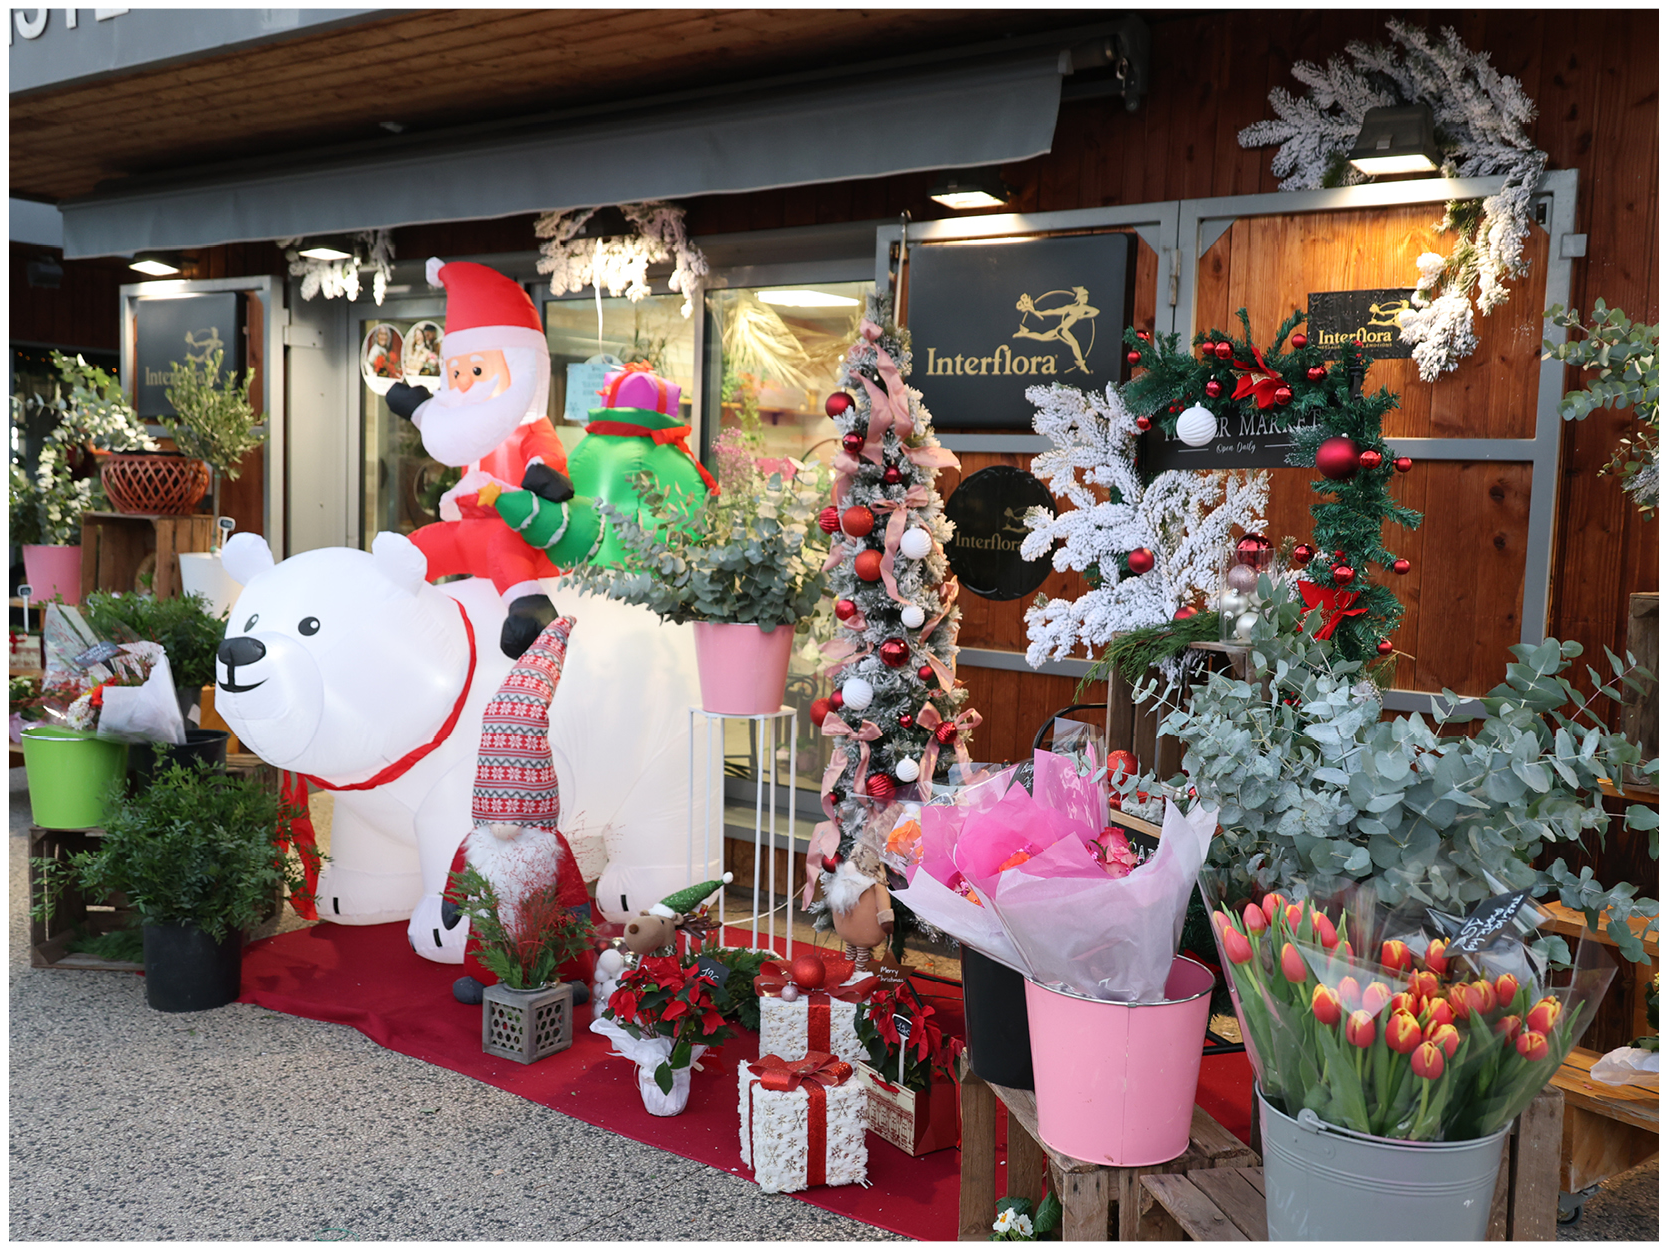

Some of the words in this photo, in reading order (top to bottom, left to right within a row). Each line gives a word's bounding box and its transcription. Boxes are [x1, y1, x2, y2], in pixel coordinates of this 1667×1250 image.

[1318, 326, 1393, 345] Interflora
[926, 344, 1058, 375] Interflora
[1238, 409, 1322, 437] MARET
[880, 966, 899, 977] Merry
